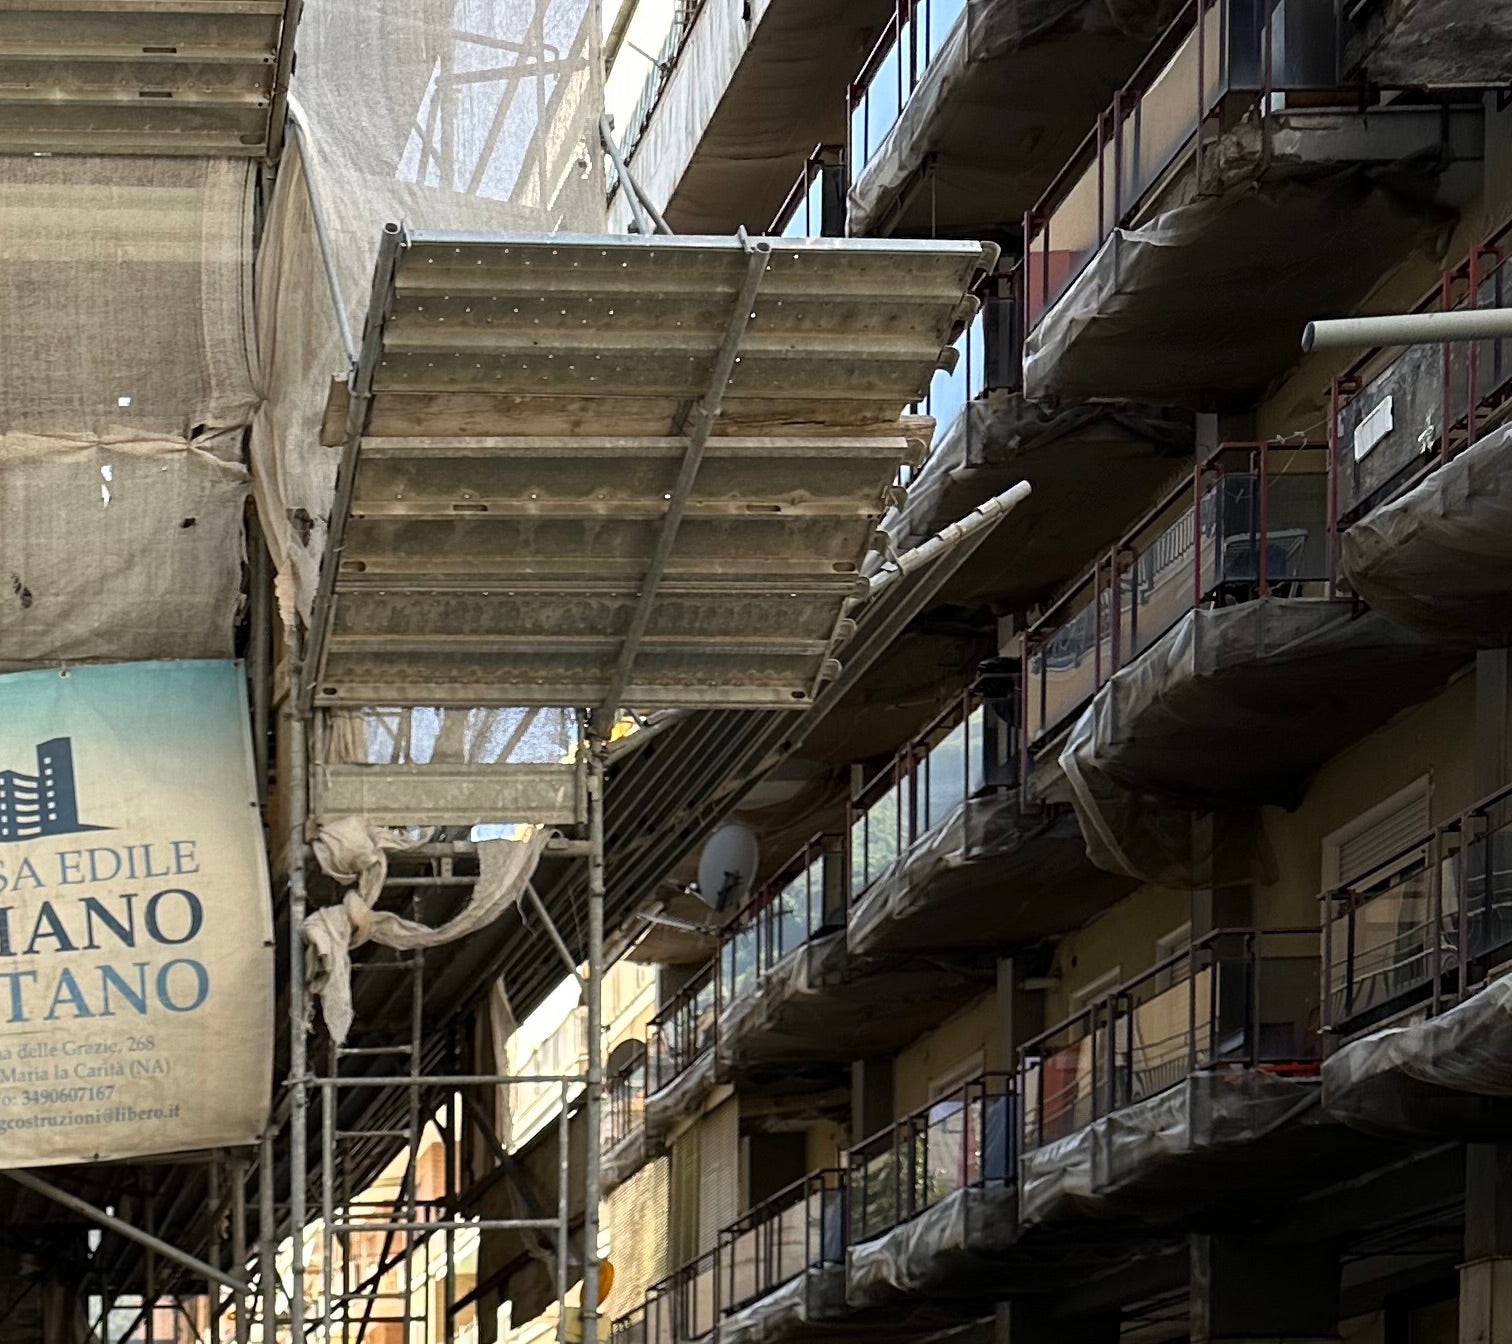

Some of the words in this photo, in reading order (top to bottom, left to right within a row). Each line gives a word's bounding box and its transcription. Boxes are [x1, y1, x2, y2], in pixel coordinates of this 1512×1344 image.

[57, 840, 201, 887] EDILE
[17, 1043, 57, 1061] delle
[127, 1035, 156, 1052] 268
[0, 1067, 49, 1085] Maria
[55, 1064, 69, 1080] la
[130, 1058, 171, 1079] (NA)
[22, 1085, 115, 1106] 3490607167
